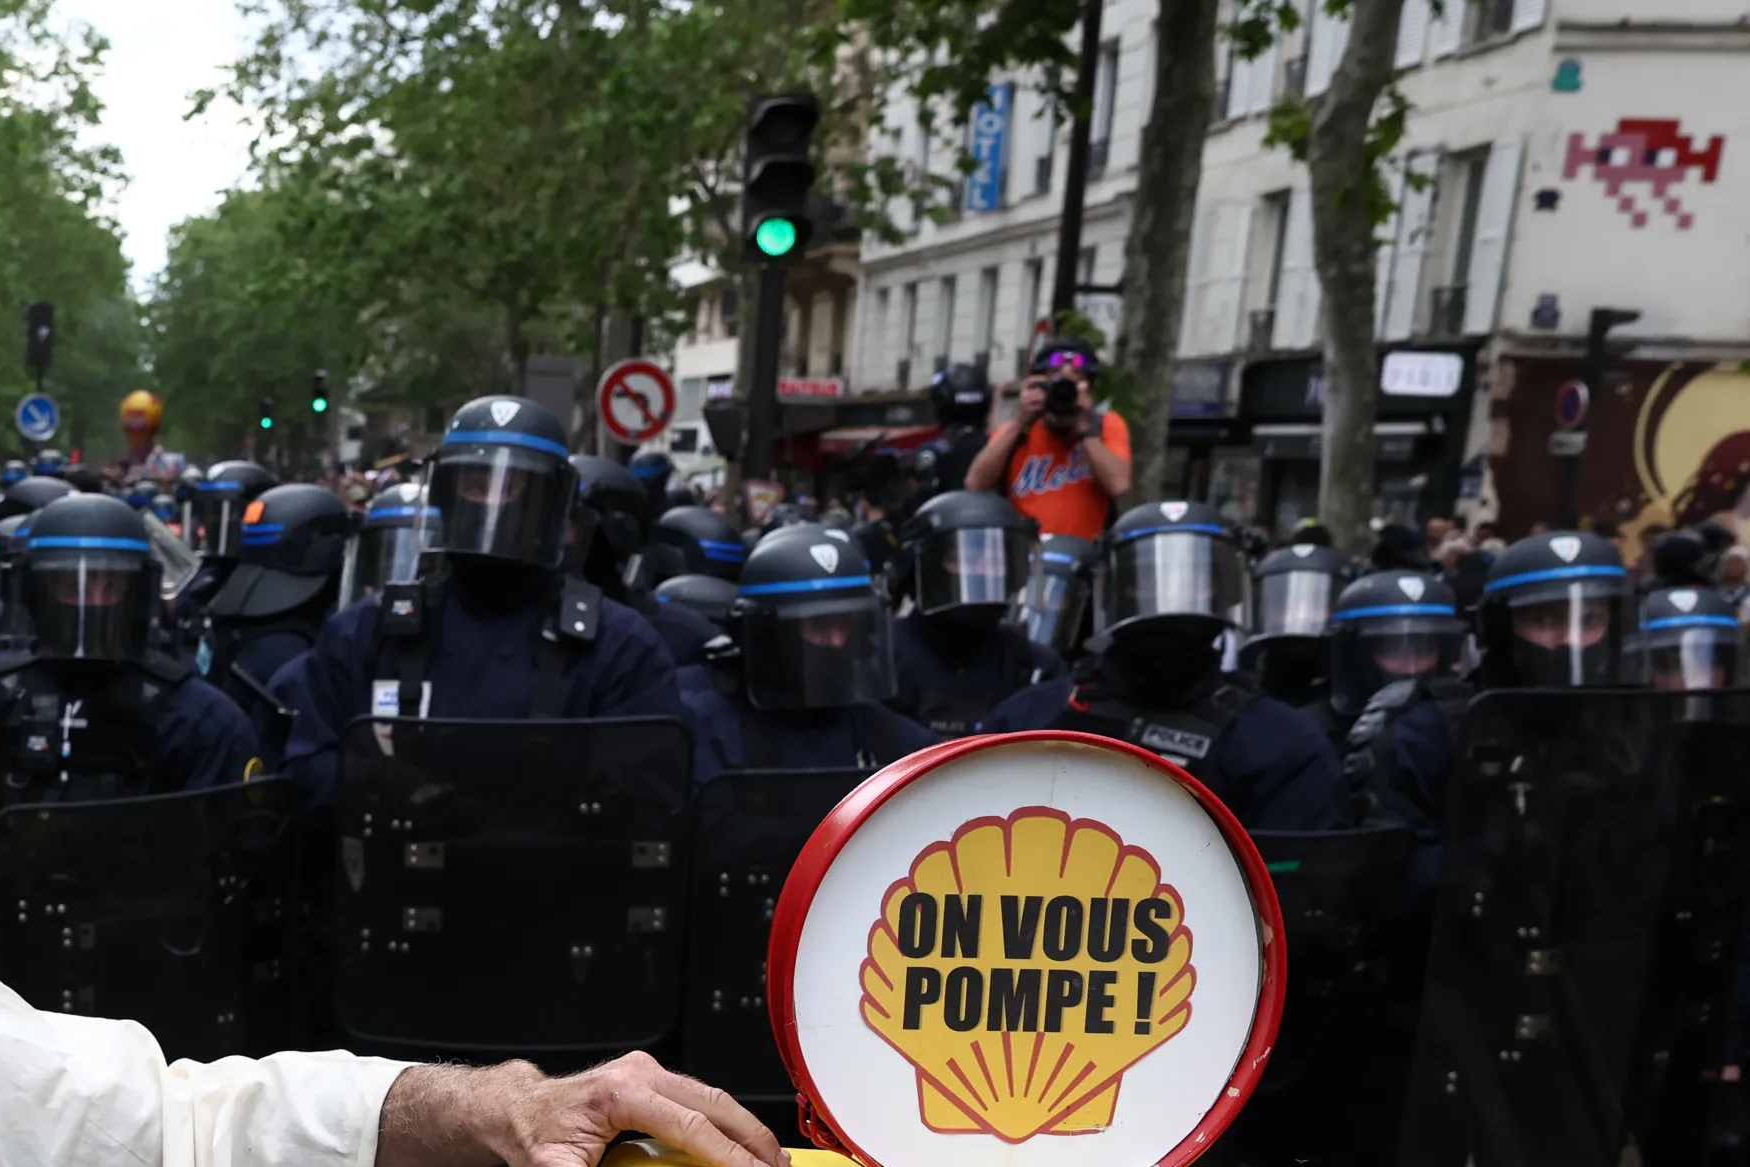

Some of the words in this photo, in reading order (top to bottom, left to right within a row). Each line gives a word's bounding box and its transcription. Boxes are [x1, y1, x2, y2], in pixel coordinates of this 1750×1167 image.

[974, 90, 1006, 208] OTEL
[898, 892, 982, 959] ON
[1000, 895, 1171, 964] VOUS
[903, 966, 1118, 1034] POMPE
